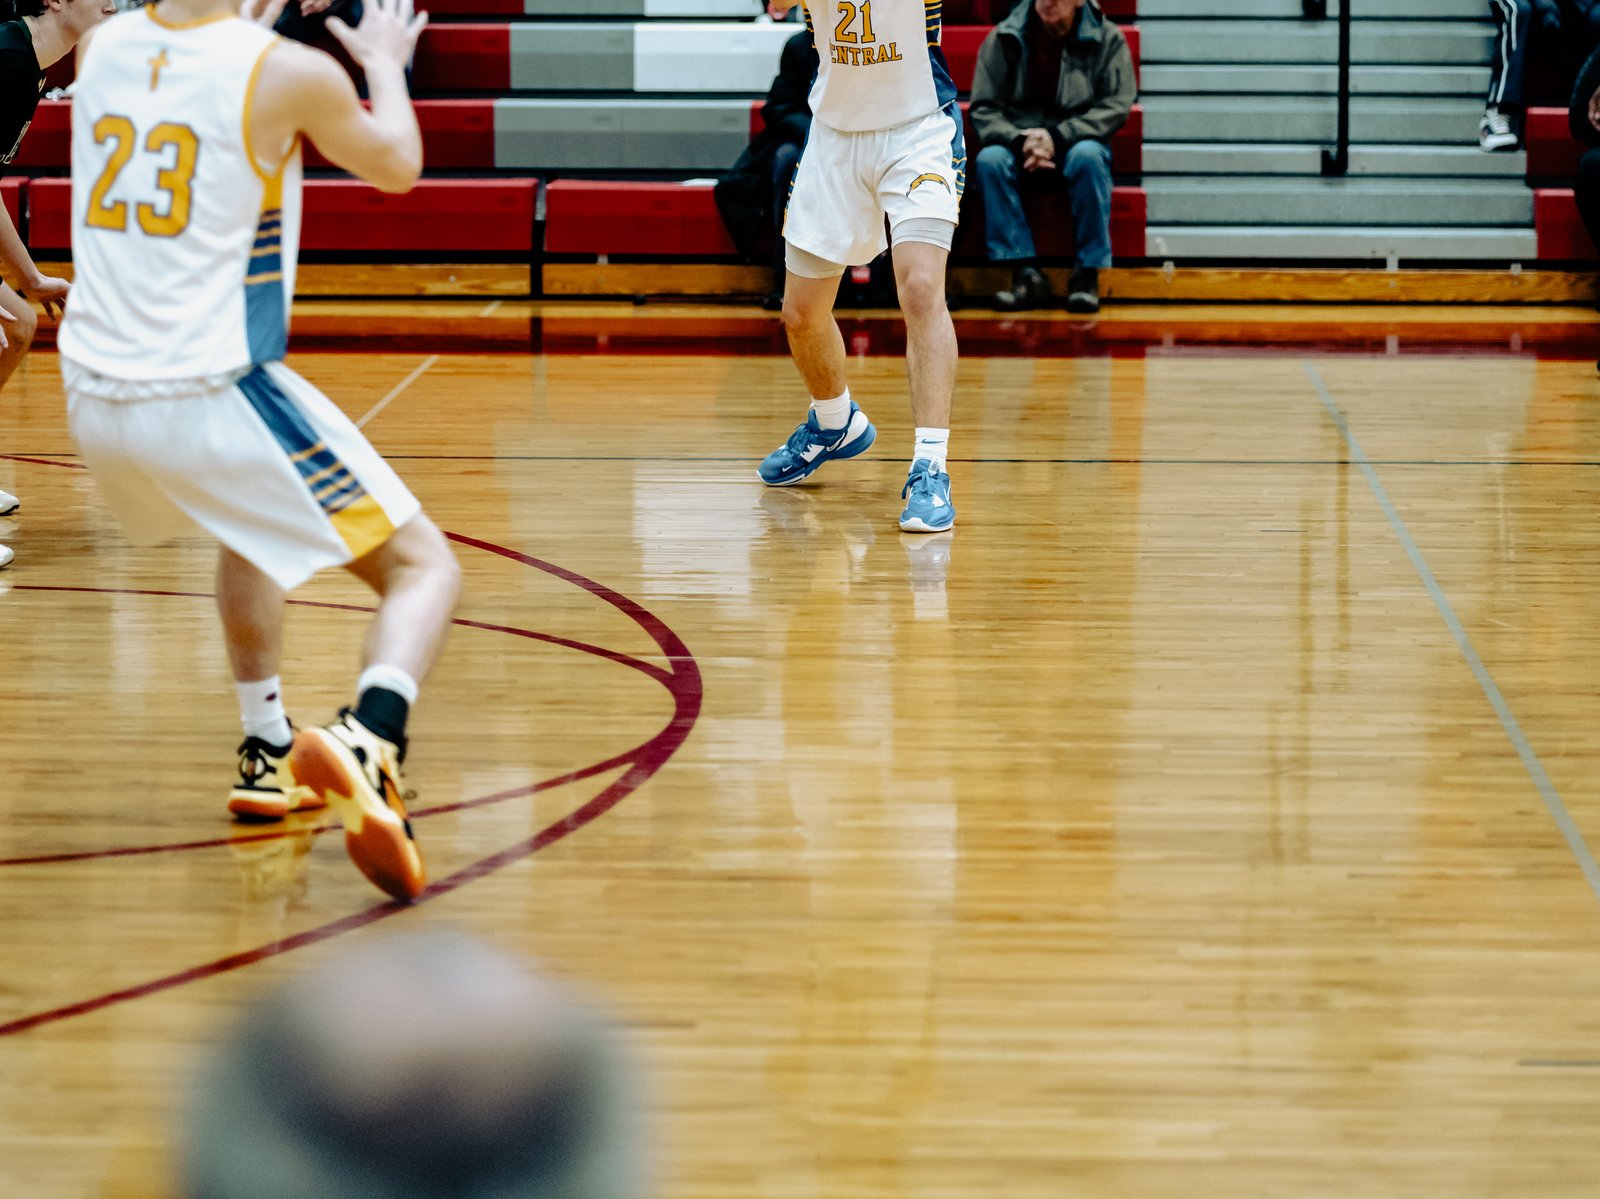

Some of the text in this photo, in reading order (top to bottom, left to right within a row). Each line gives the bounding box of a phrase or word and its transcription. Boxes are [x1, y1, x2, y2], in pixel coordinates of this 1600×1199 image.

[834, 0, 877, 44] 21
[829, 41, 903, 66] ENTRAL
[84, 112, 201, 238] 23
